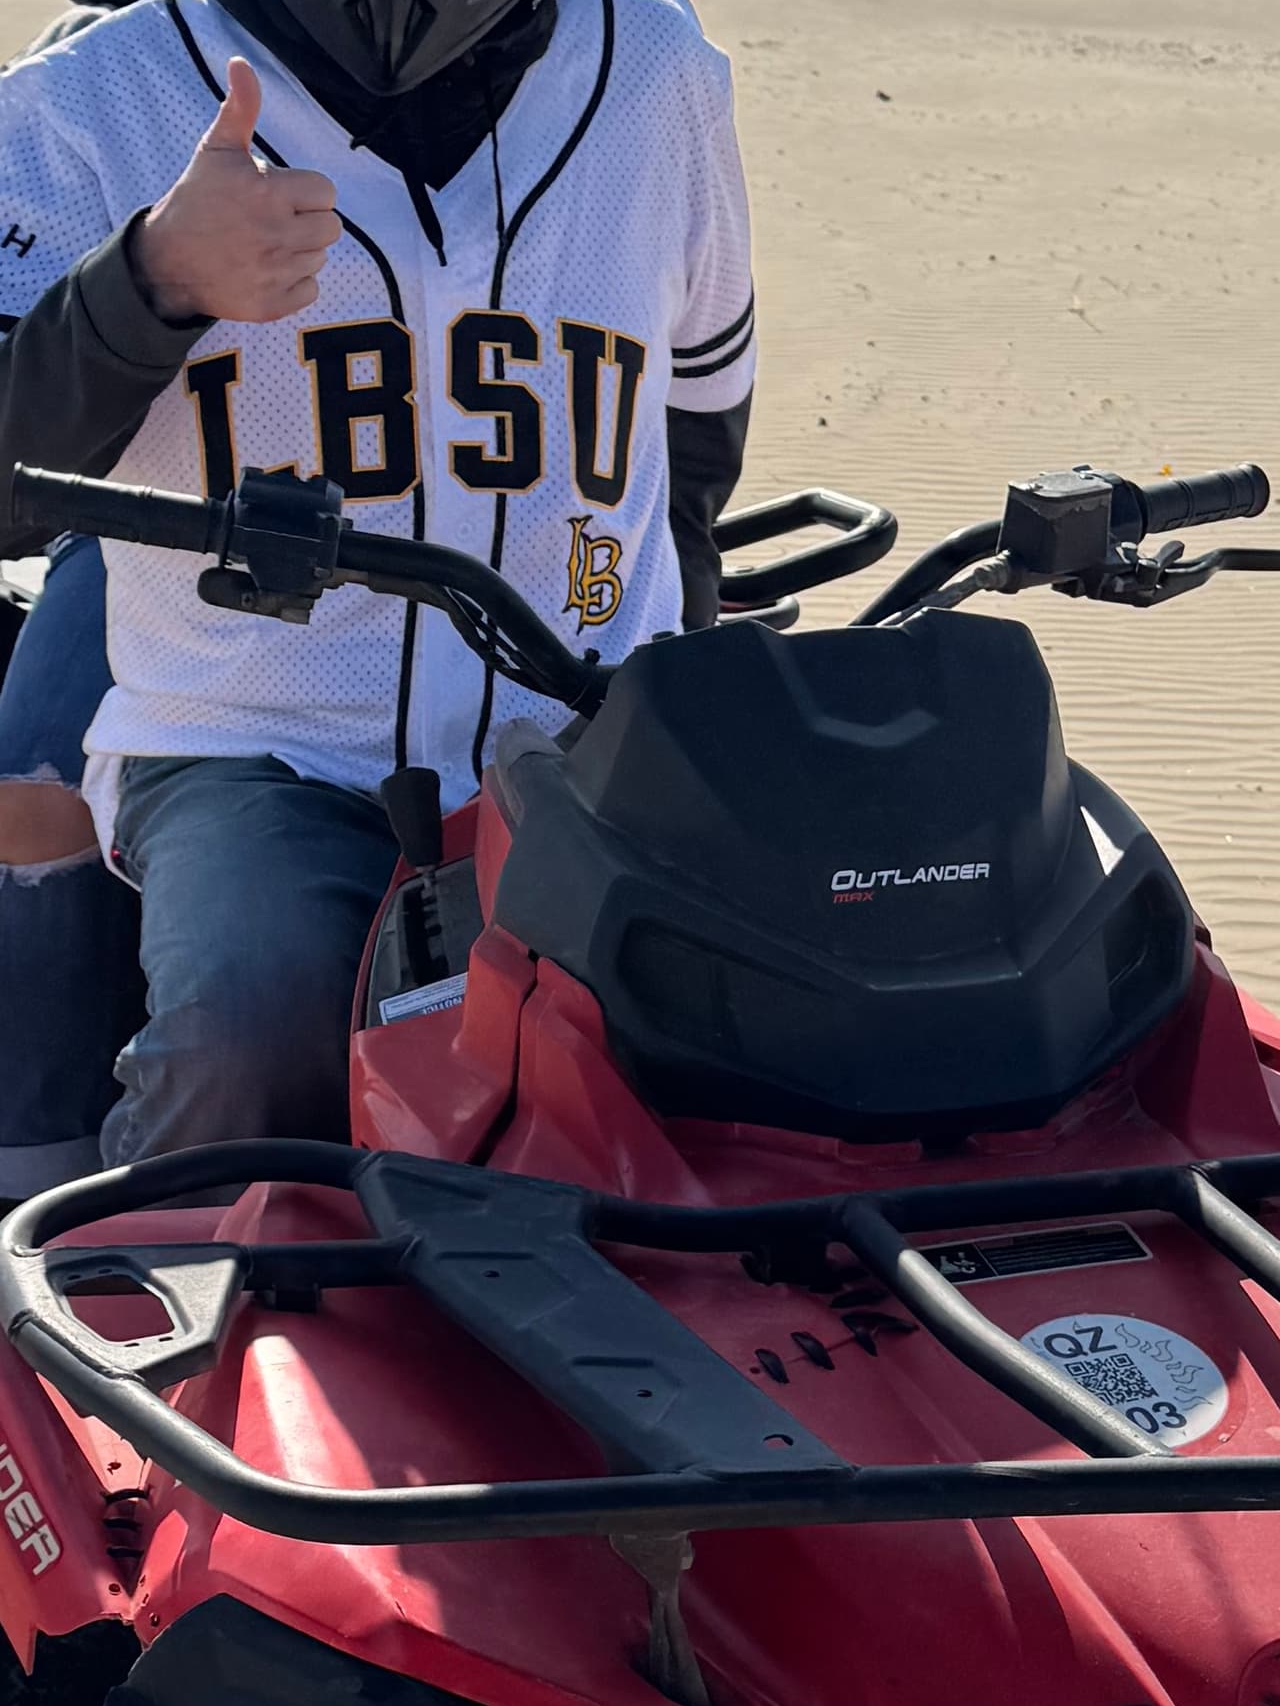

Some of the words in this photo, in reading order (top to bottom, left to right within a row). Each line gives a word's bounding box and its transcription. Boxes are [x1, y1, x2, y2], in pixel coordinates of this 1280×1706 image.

[184, 308, 648, 510] LBSU
[831, 863, 990, 891] OUTLANDER
[1043, 1325, 1118, 1359] QZ
